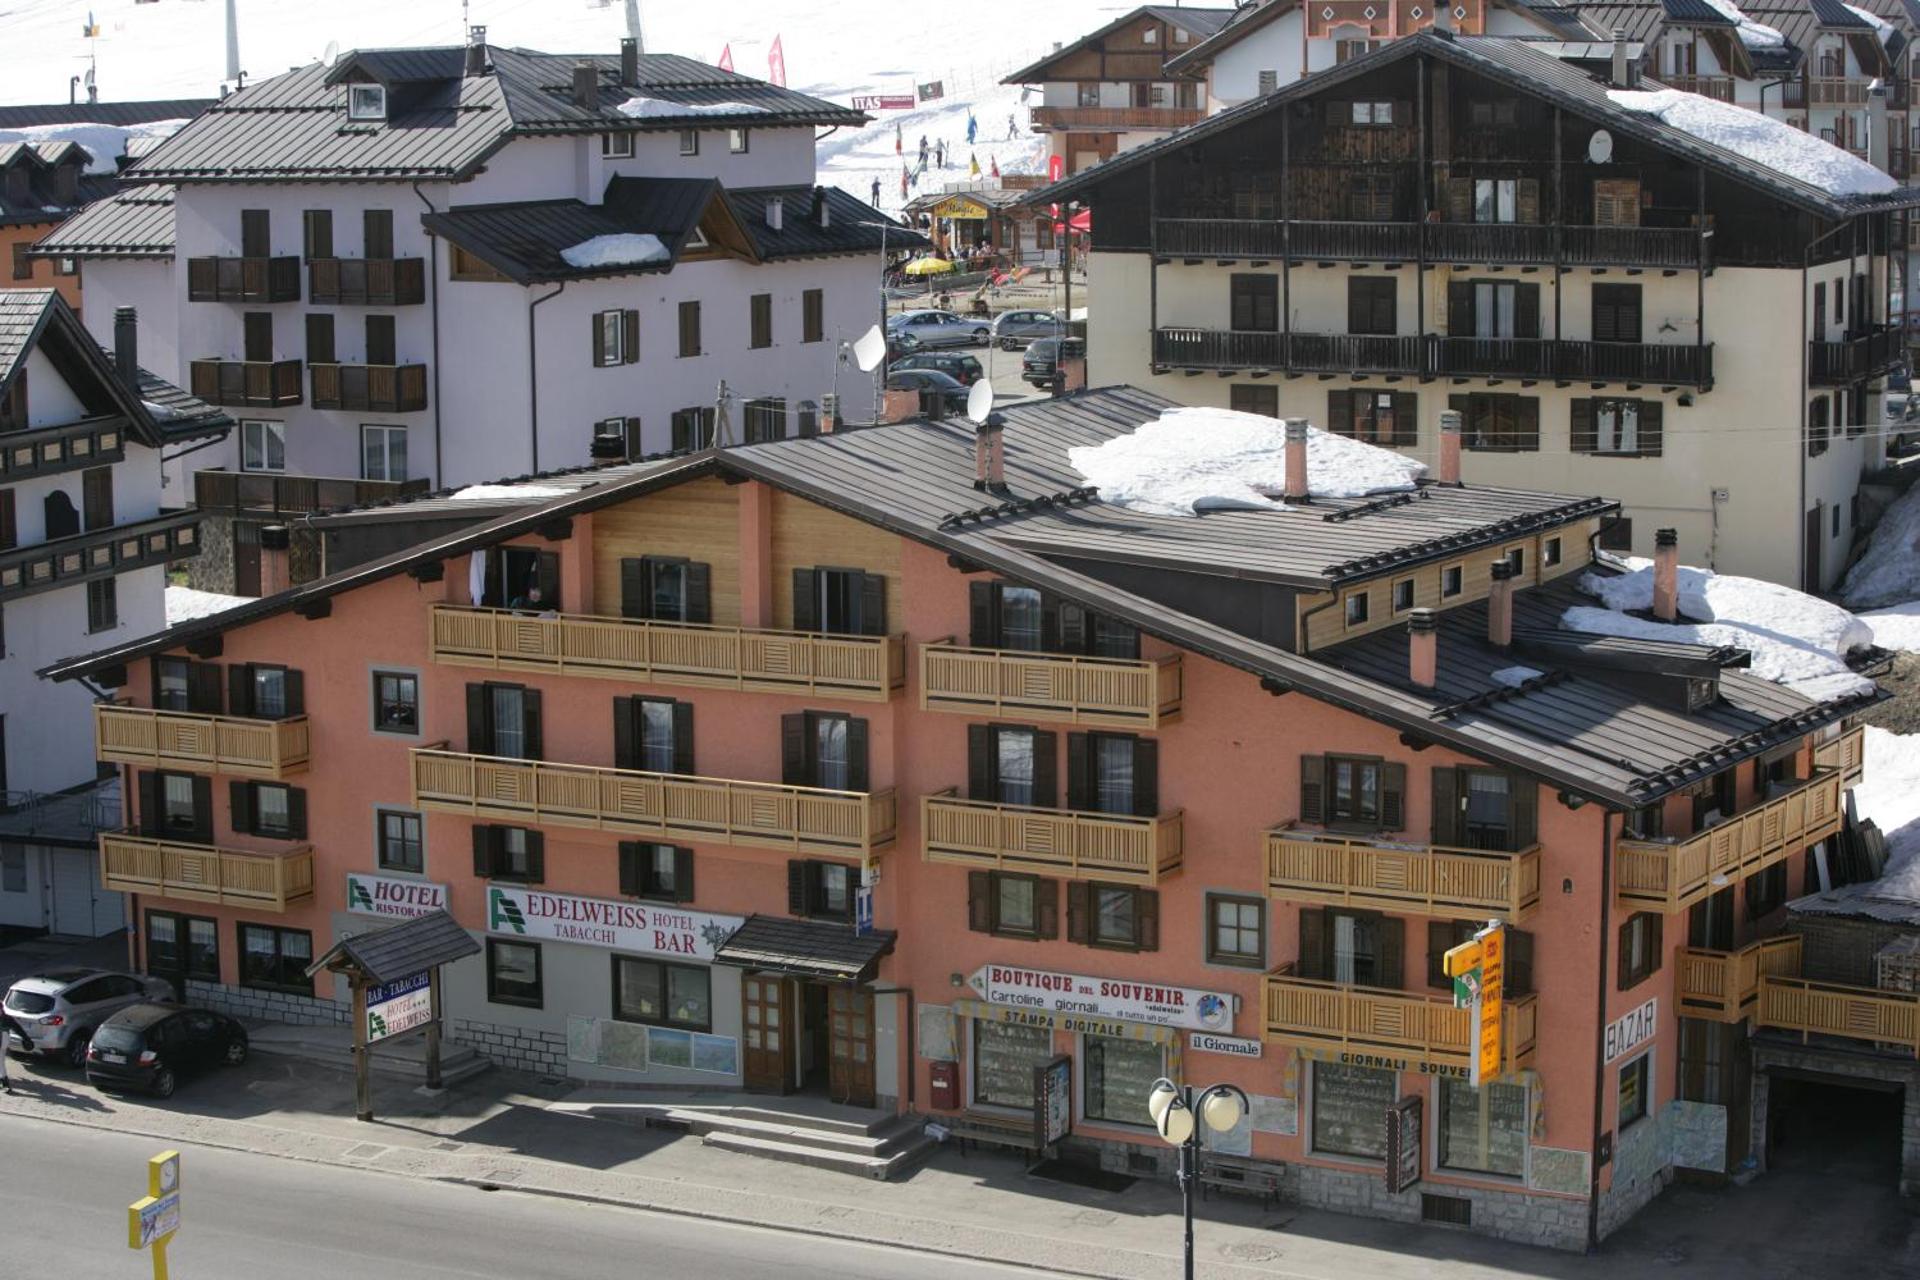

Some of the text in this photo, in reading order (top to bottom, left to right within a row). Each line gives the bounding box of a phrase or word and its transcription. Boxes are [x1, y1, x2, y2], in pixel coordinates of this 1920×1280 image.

[854, 96, 881, 110] ITAS
[375, 881, 444, 907] HOTEL
[527, 894, 696, 931] EDELWEISS HOTEL
[554, 923, 697, 954] TABACCHI BAR
[368, 987, 383, 1005] BAR
[390, 972, 429, 996] TABACCHI
[992, 968, 1073, 993] BOUTIQUE
[1101, 982, 1185, 1006] SOUVENIR
[992, 989, 1044, 1007] Cartoline
[387, 997, 411, 1019] HOTEL
[387, 1007, 431, 1034] EDELWEISS
[1005, 1010, 1124, 1036] STAMPA DIGITALE
[1607, 1001, 1654, 1061] BAZAR
[1193, 1036, 1259, 1056] il Giornale
[1341, 1052, 1406, 1070] GIORNALI
